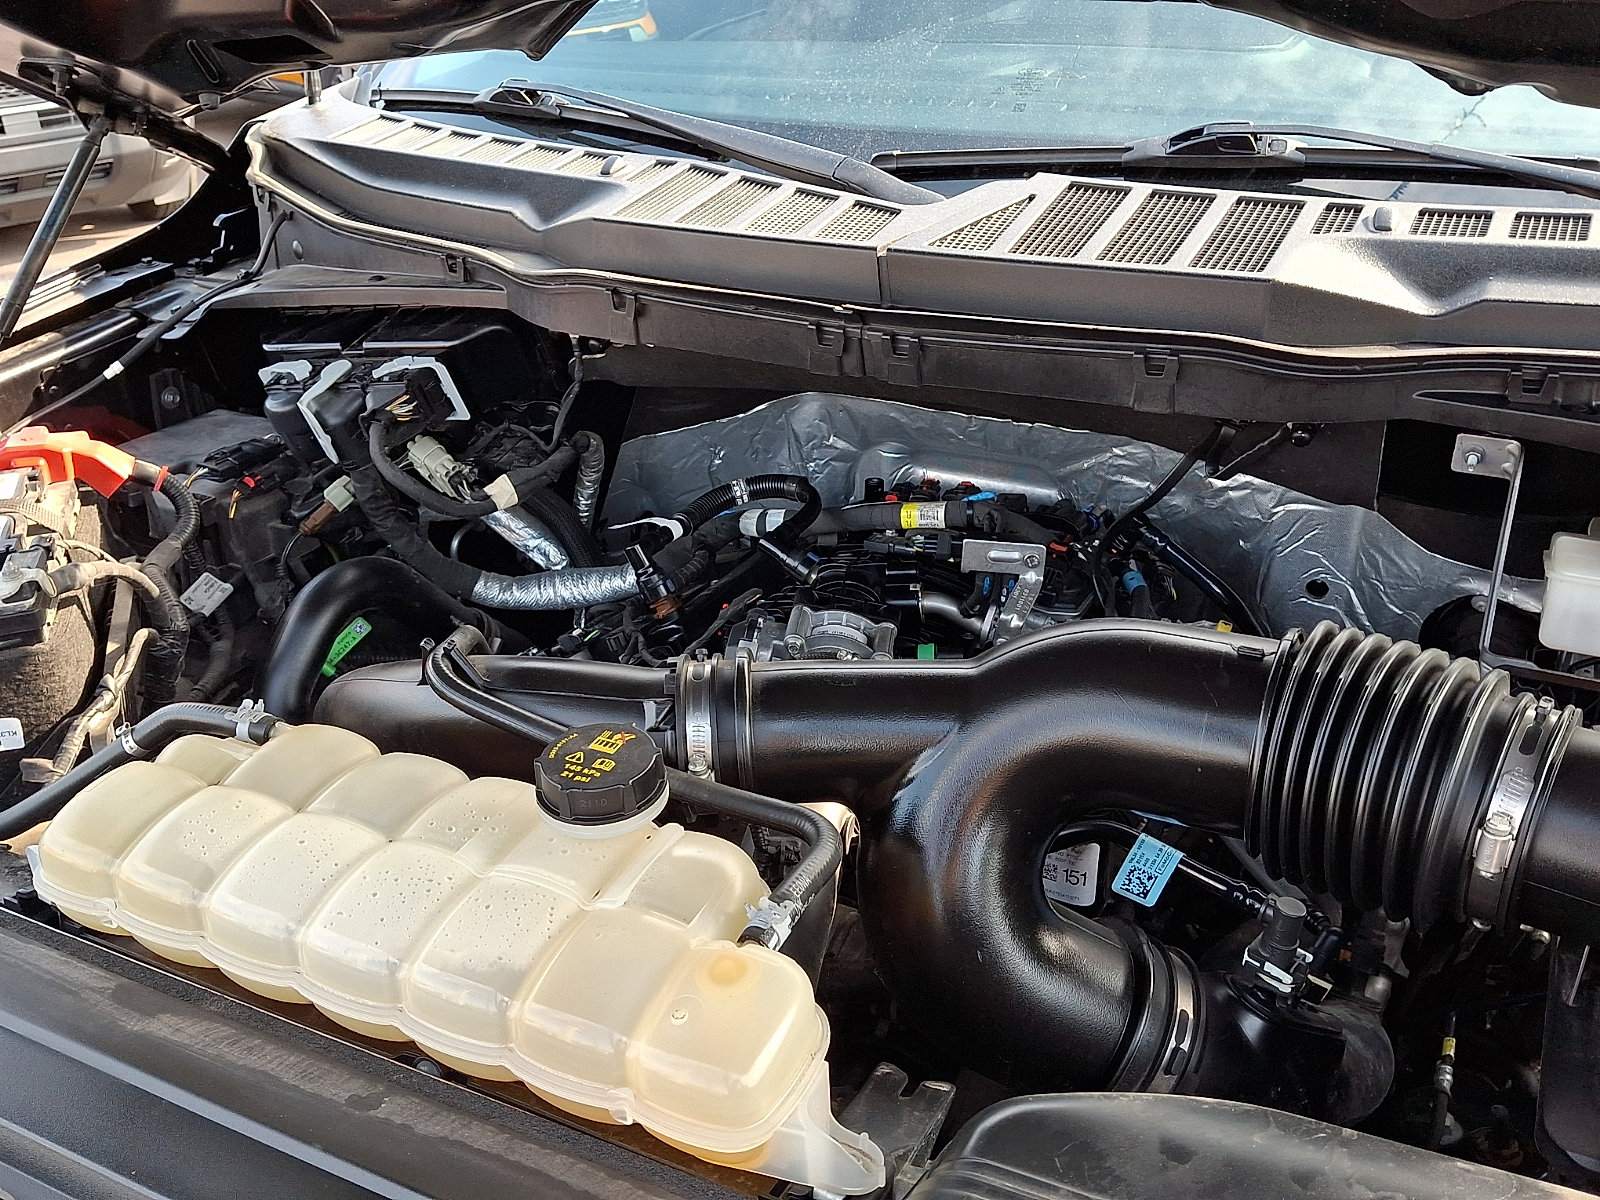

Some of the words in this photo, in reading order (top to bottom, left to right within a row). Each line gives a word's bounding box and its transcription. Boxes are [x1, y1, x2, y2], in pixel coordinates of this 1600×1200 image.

[564, 763, 582, 772] 145
[582, 767, 602, 778] kPa
[573, 774, 592, 783] psi
[1062, 868, 1088, 887] 151
